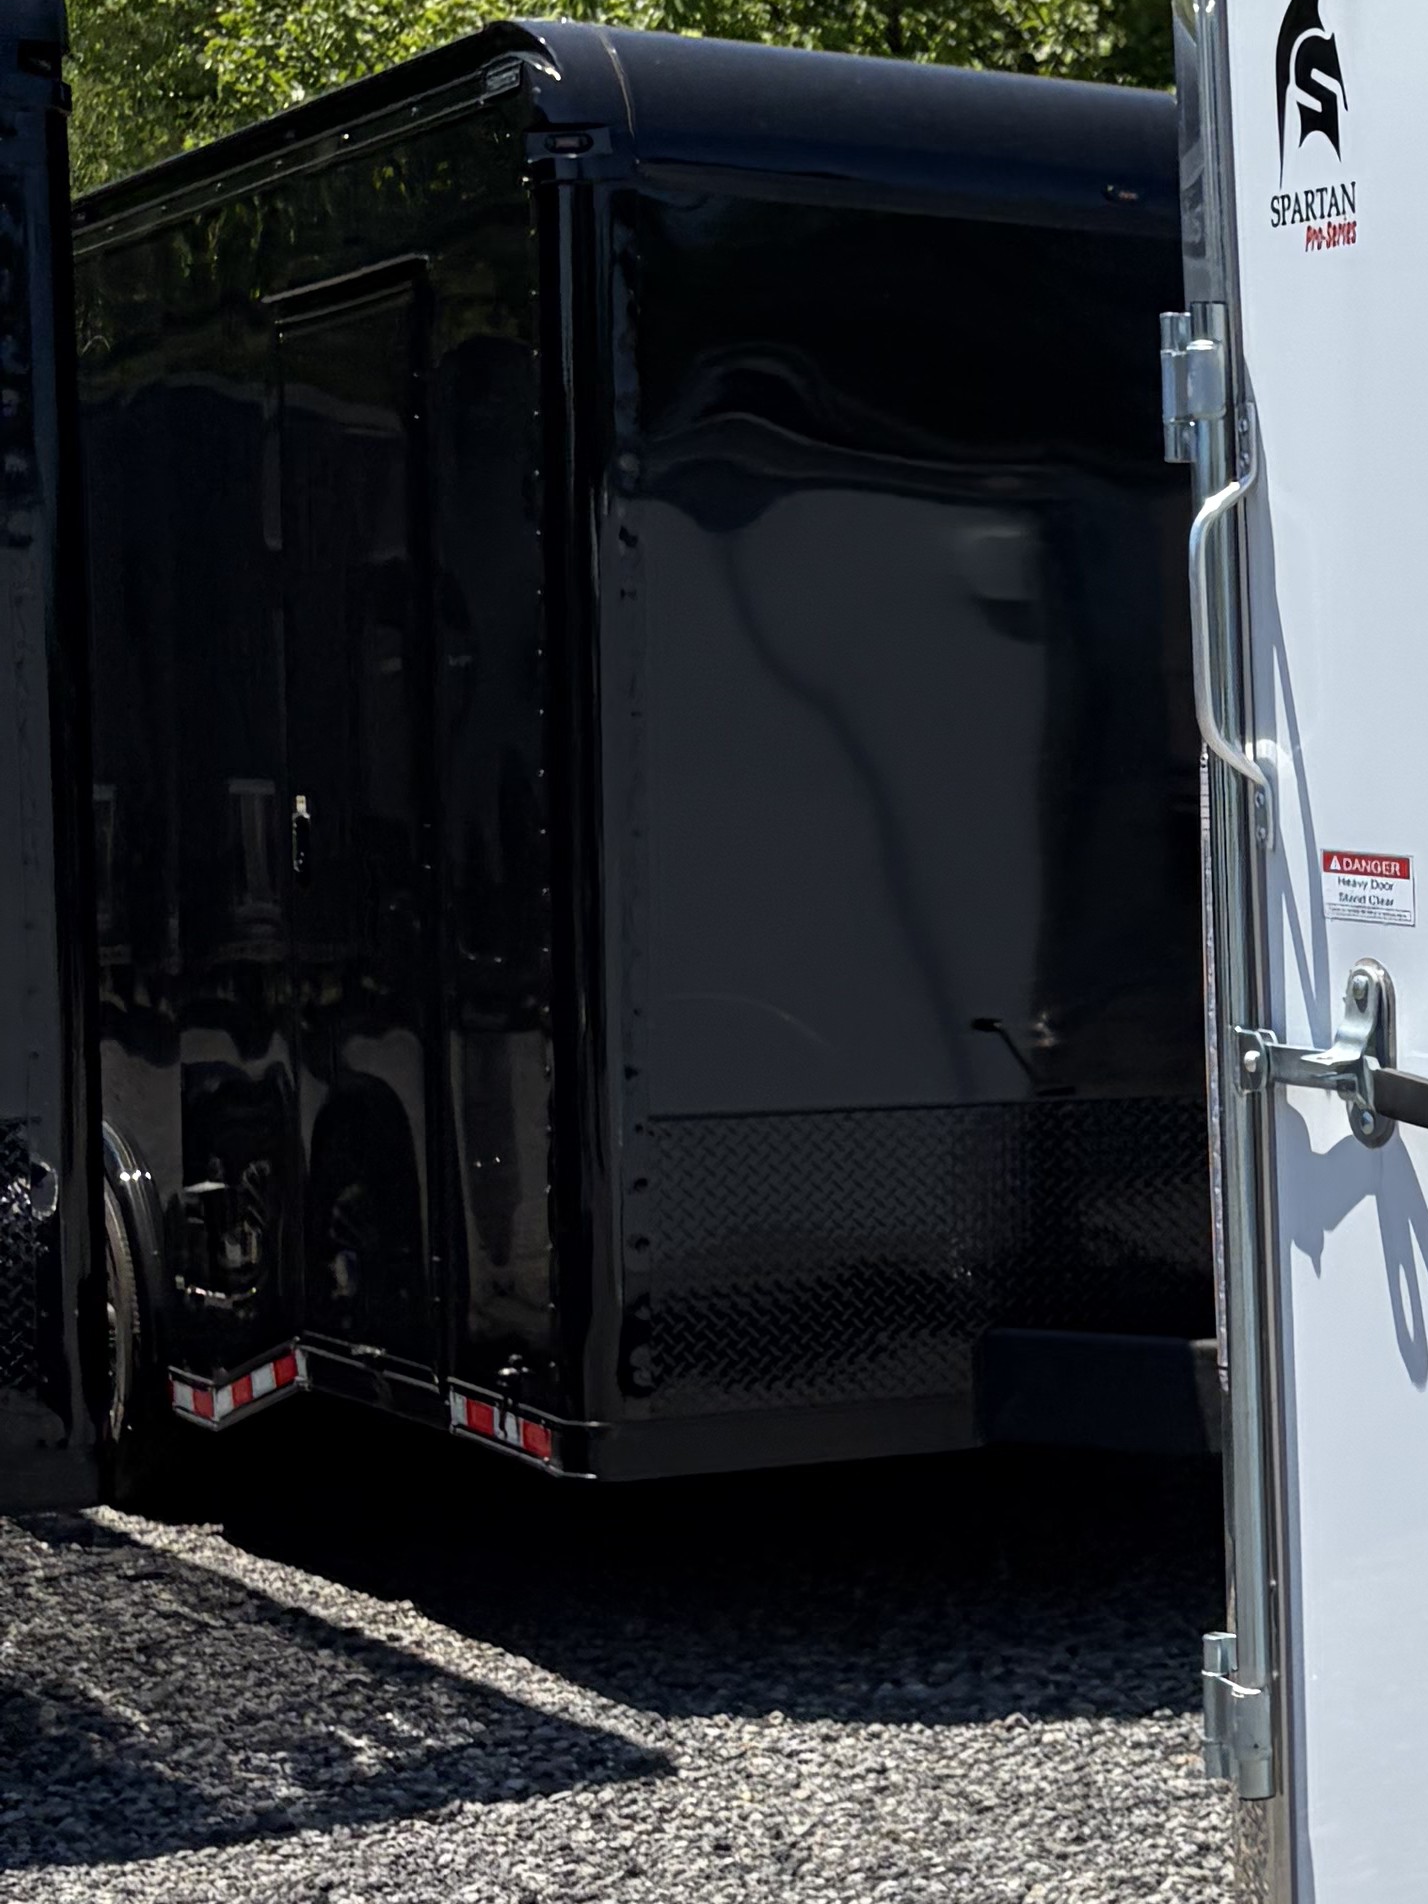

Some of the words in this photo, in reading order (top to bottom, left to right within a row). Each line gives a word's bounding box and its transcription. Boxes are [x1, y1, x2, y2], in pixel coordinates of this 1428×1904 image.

[1270, 181, 1356, 228] SPARTAN
[1305, 218, 1357, 252] Pro-Series
[1343, 858, 1400, 876] DANGER
[1338, 876, 1368, 891] Heavy
[1371, 879, 1394, 891] Door
